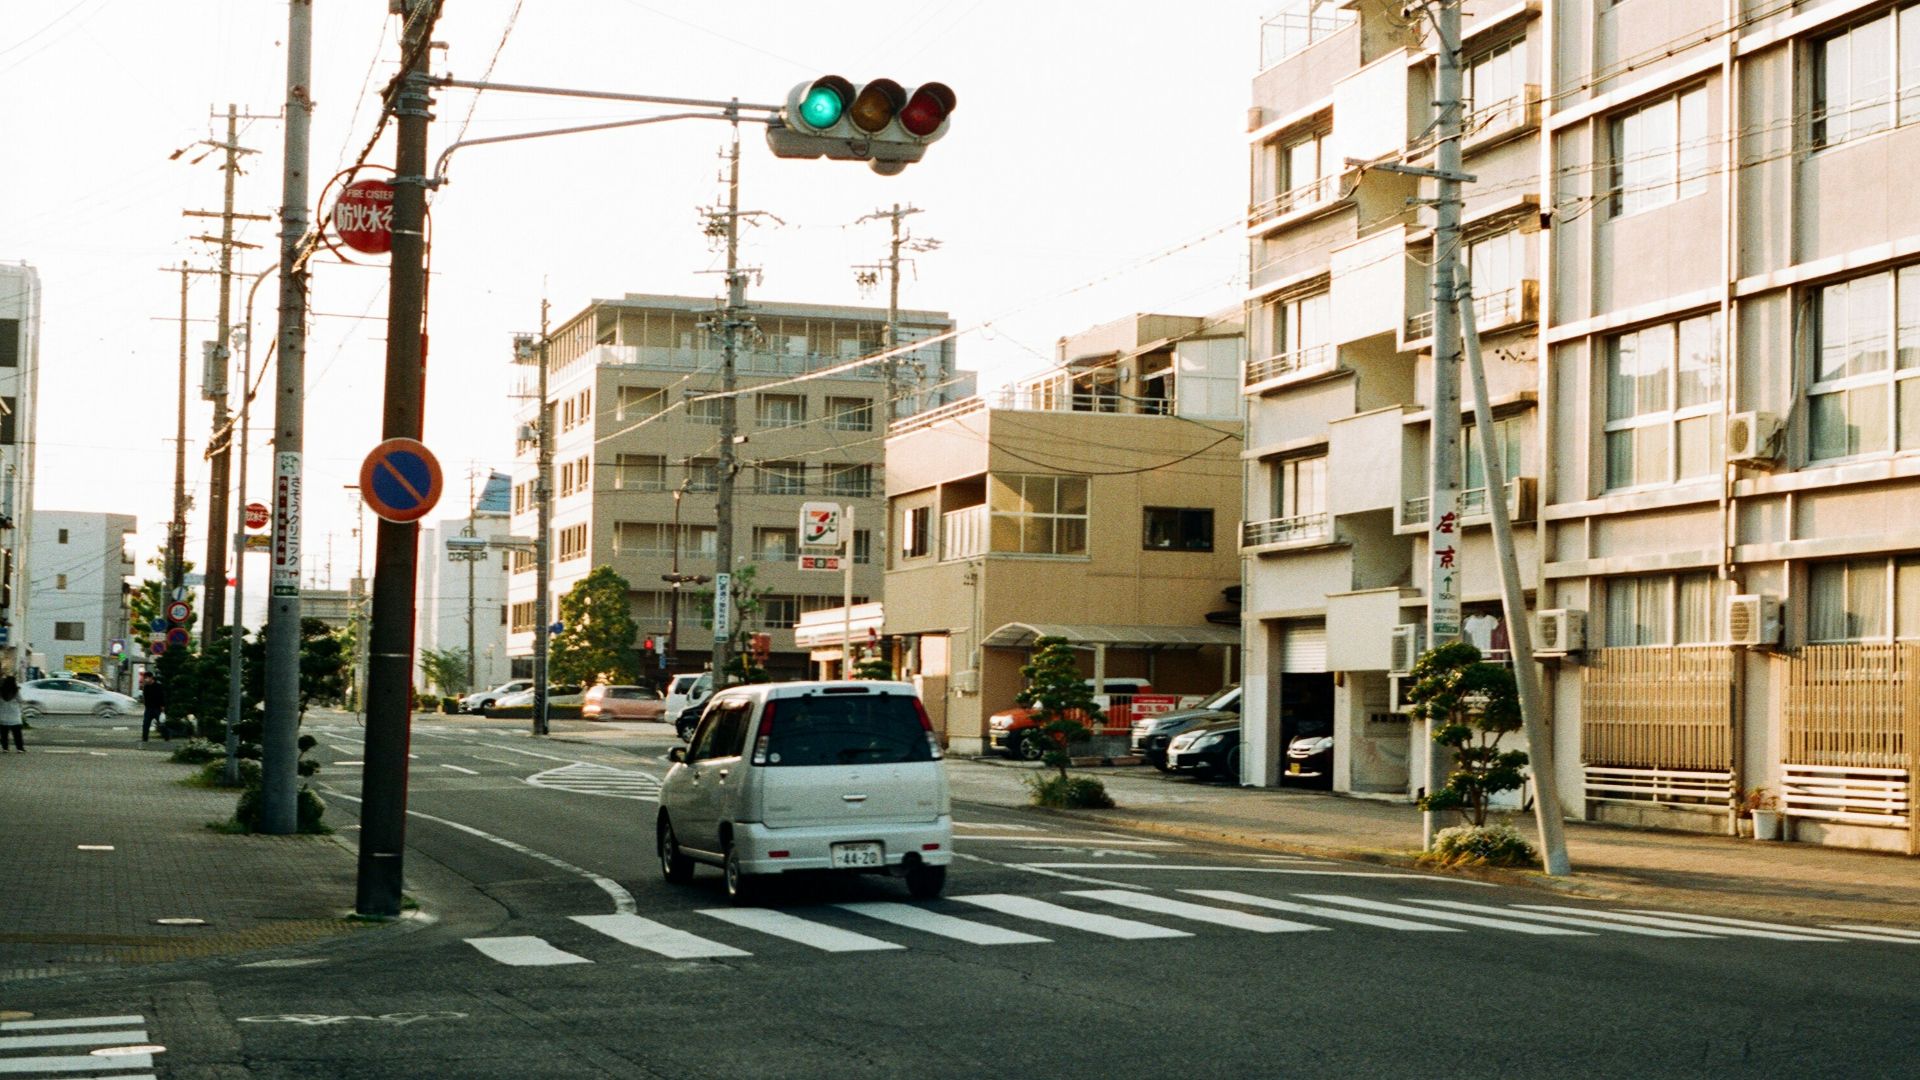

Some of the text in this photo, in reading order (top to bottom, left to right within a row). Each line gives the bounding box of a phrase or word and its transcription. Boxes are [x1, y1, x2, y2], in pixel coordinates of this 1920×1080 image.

[347, 190, 394, 199] FIRE CISTER
[337, 202, 394, 233] 防火水そ
[1435, 511, 1456, 569] 左京
